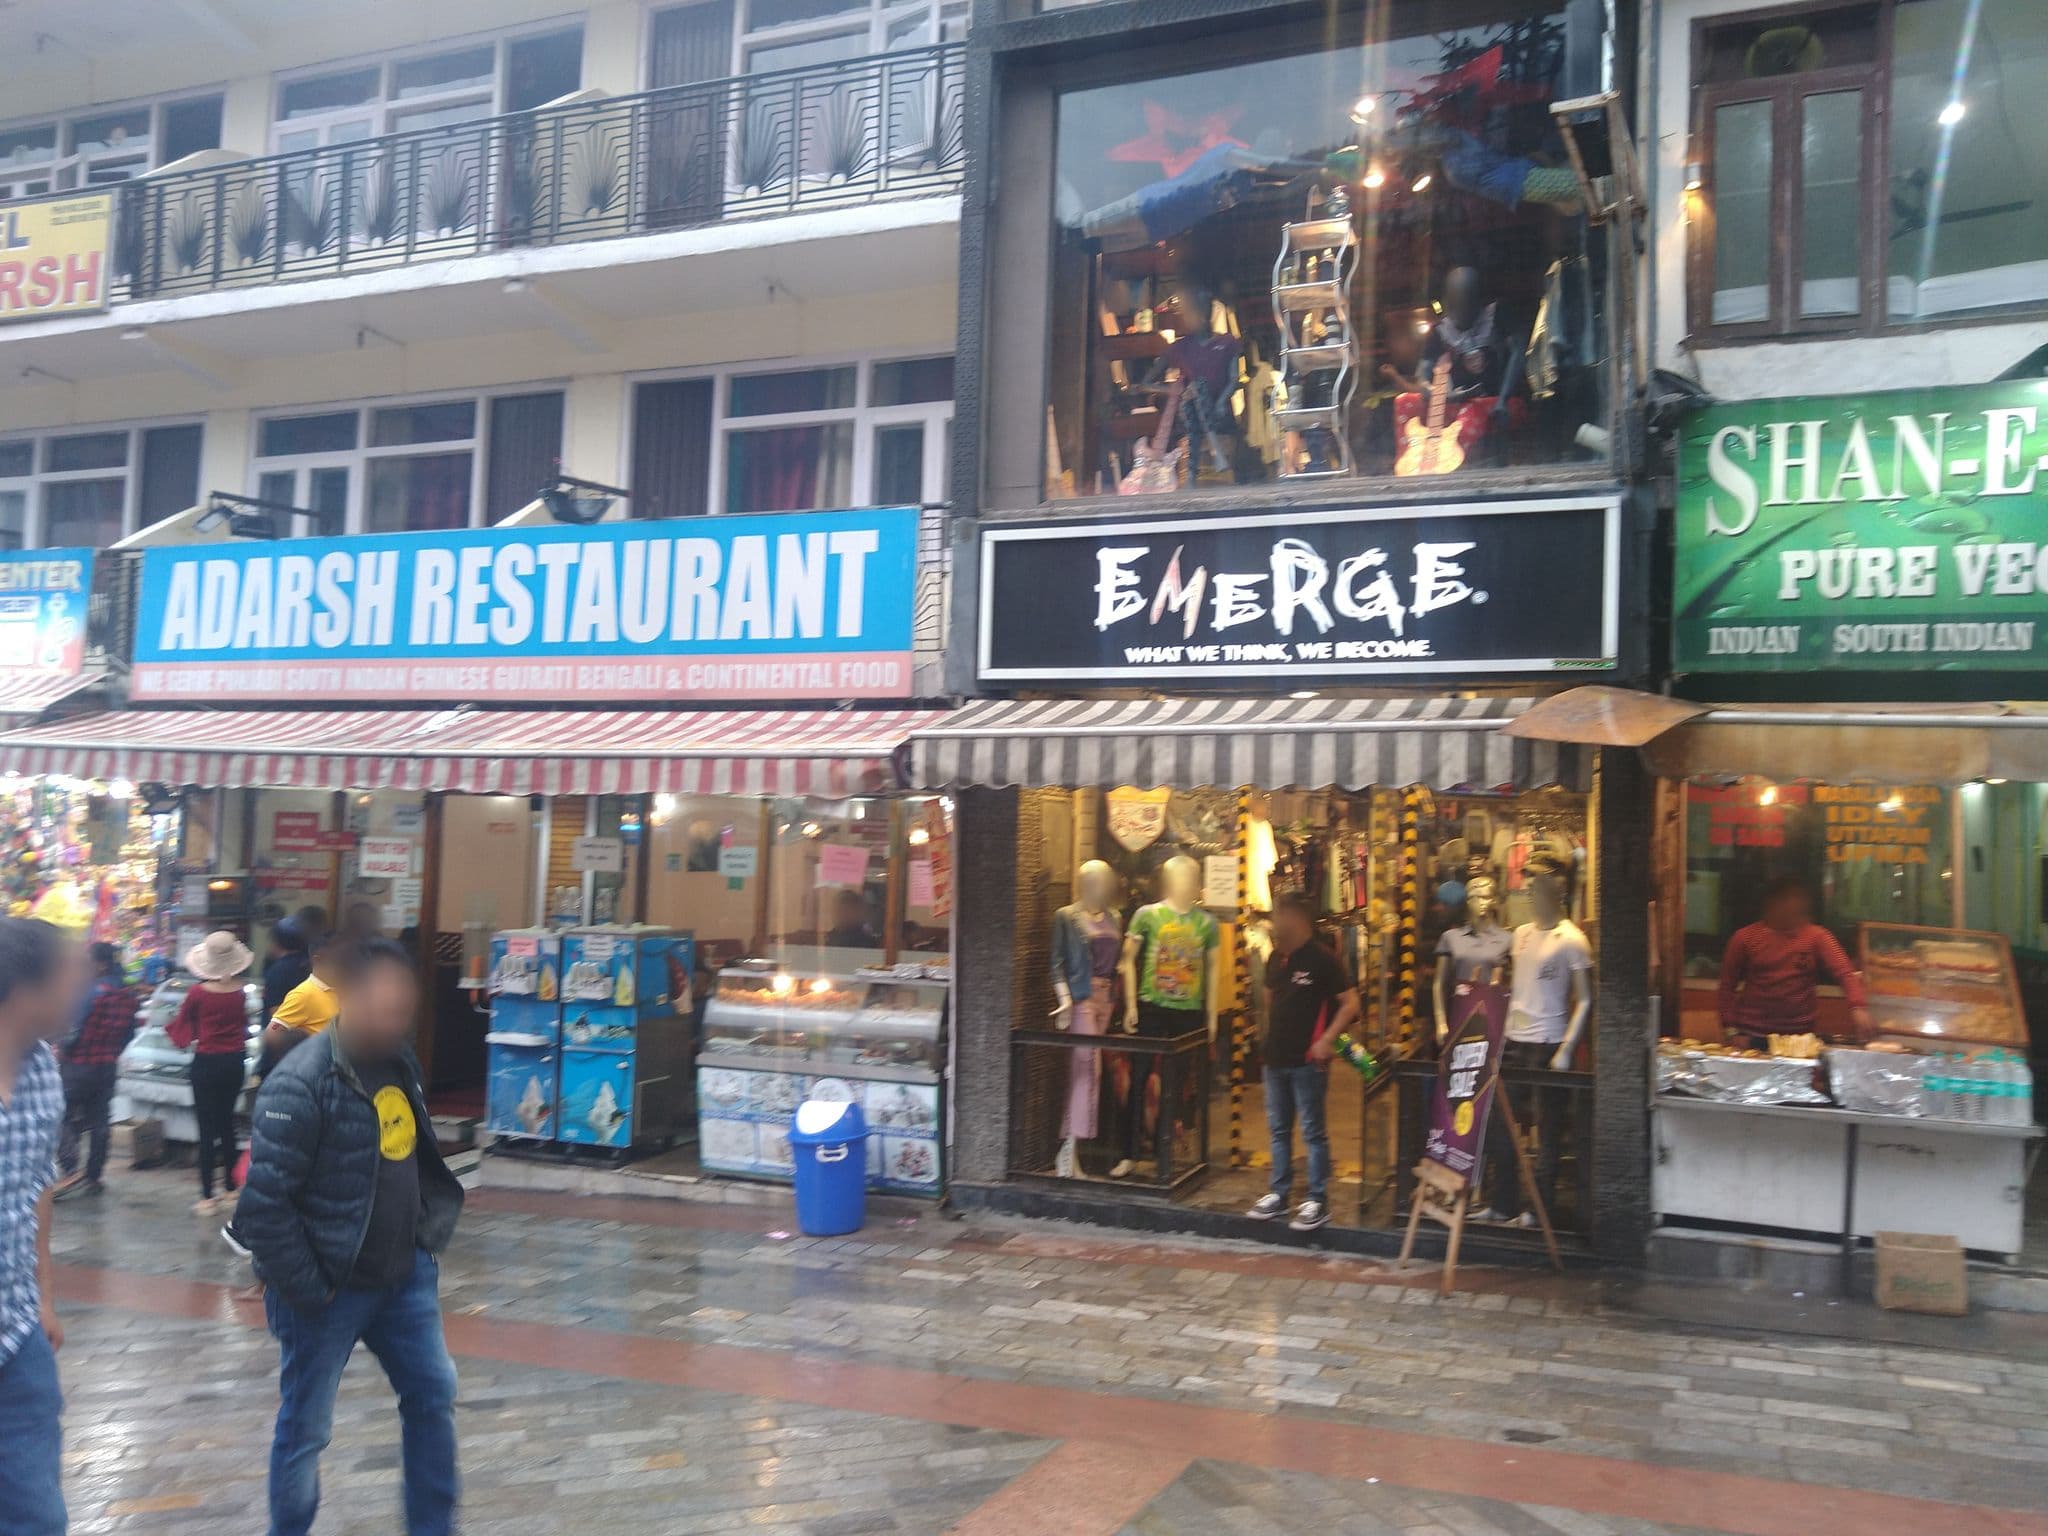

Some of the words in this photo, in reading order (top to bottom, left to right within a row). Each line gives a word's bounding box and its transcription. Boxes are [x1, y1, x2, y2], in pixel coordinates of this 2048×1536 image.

[0, 211, 30, 249] L
[1777, 543, 1938, 599] PURE
[1952, 542, 2048, 596] VE
[159, 549, 400, 650] ADARSH
[408, 530, 879, 645] RESTAURANT
[1094, 538, 1477, 639] EMERGE
[1124, 646, 1186, 663] WHAT
[1184, 645, 1220, 662] WE
[1221, 643, 1293, 664] THINK,
[1296, 642, 1333, 660] WE
[1707, 626, 1801, 655] INDIAN
[1833, 624, 1929, 653] SOUTH
[1932, 622, 2036, 652] INDIAN
[411, 666, 489, 690] CHINESE
[577, 664, 663, 690] BENGALI
[666, 668, 682, 689] &
[688, 662, 833, 689] CONTINENTAL
[839, 661, 900, 688] FOOD
[1826, 806, 1928, 824] IDLY
